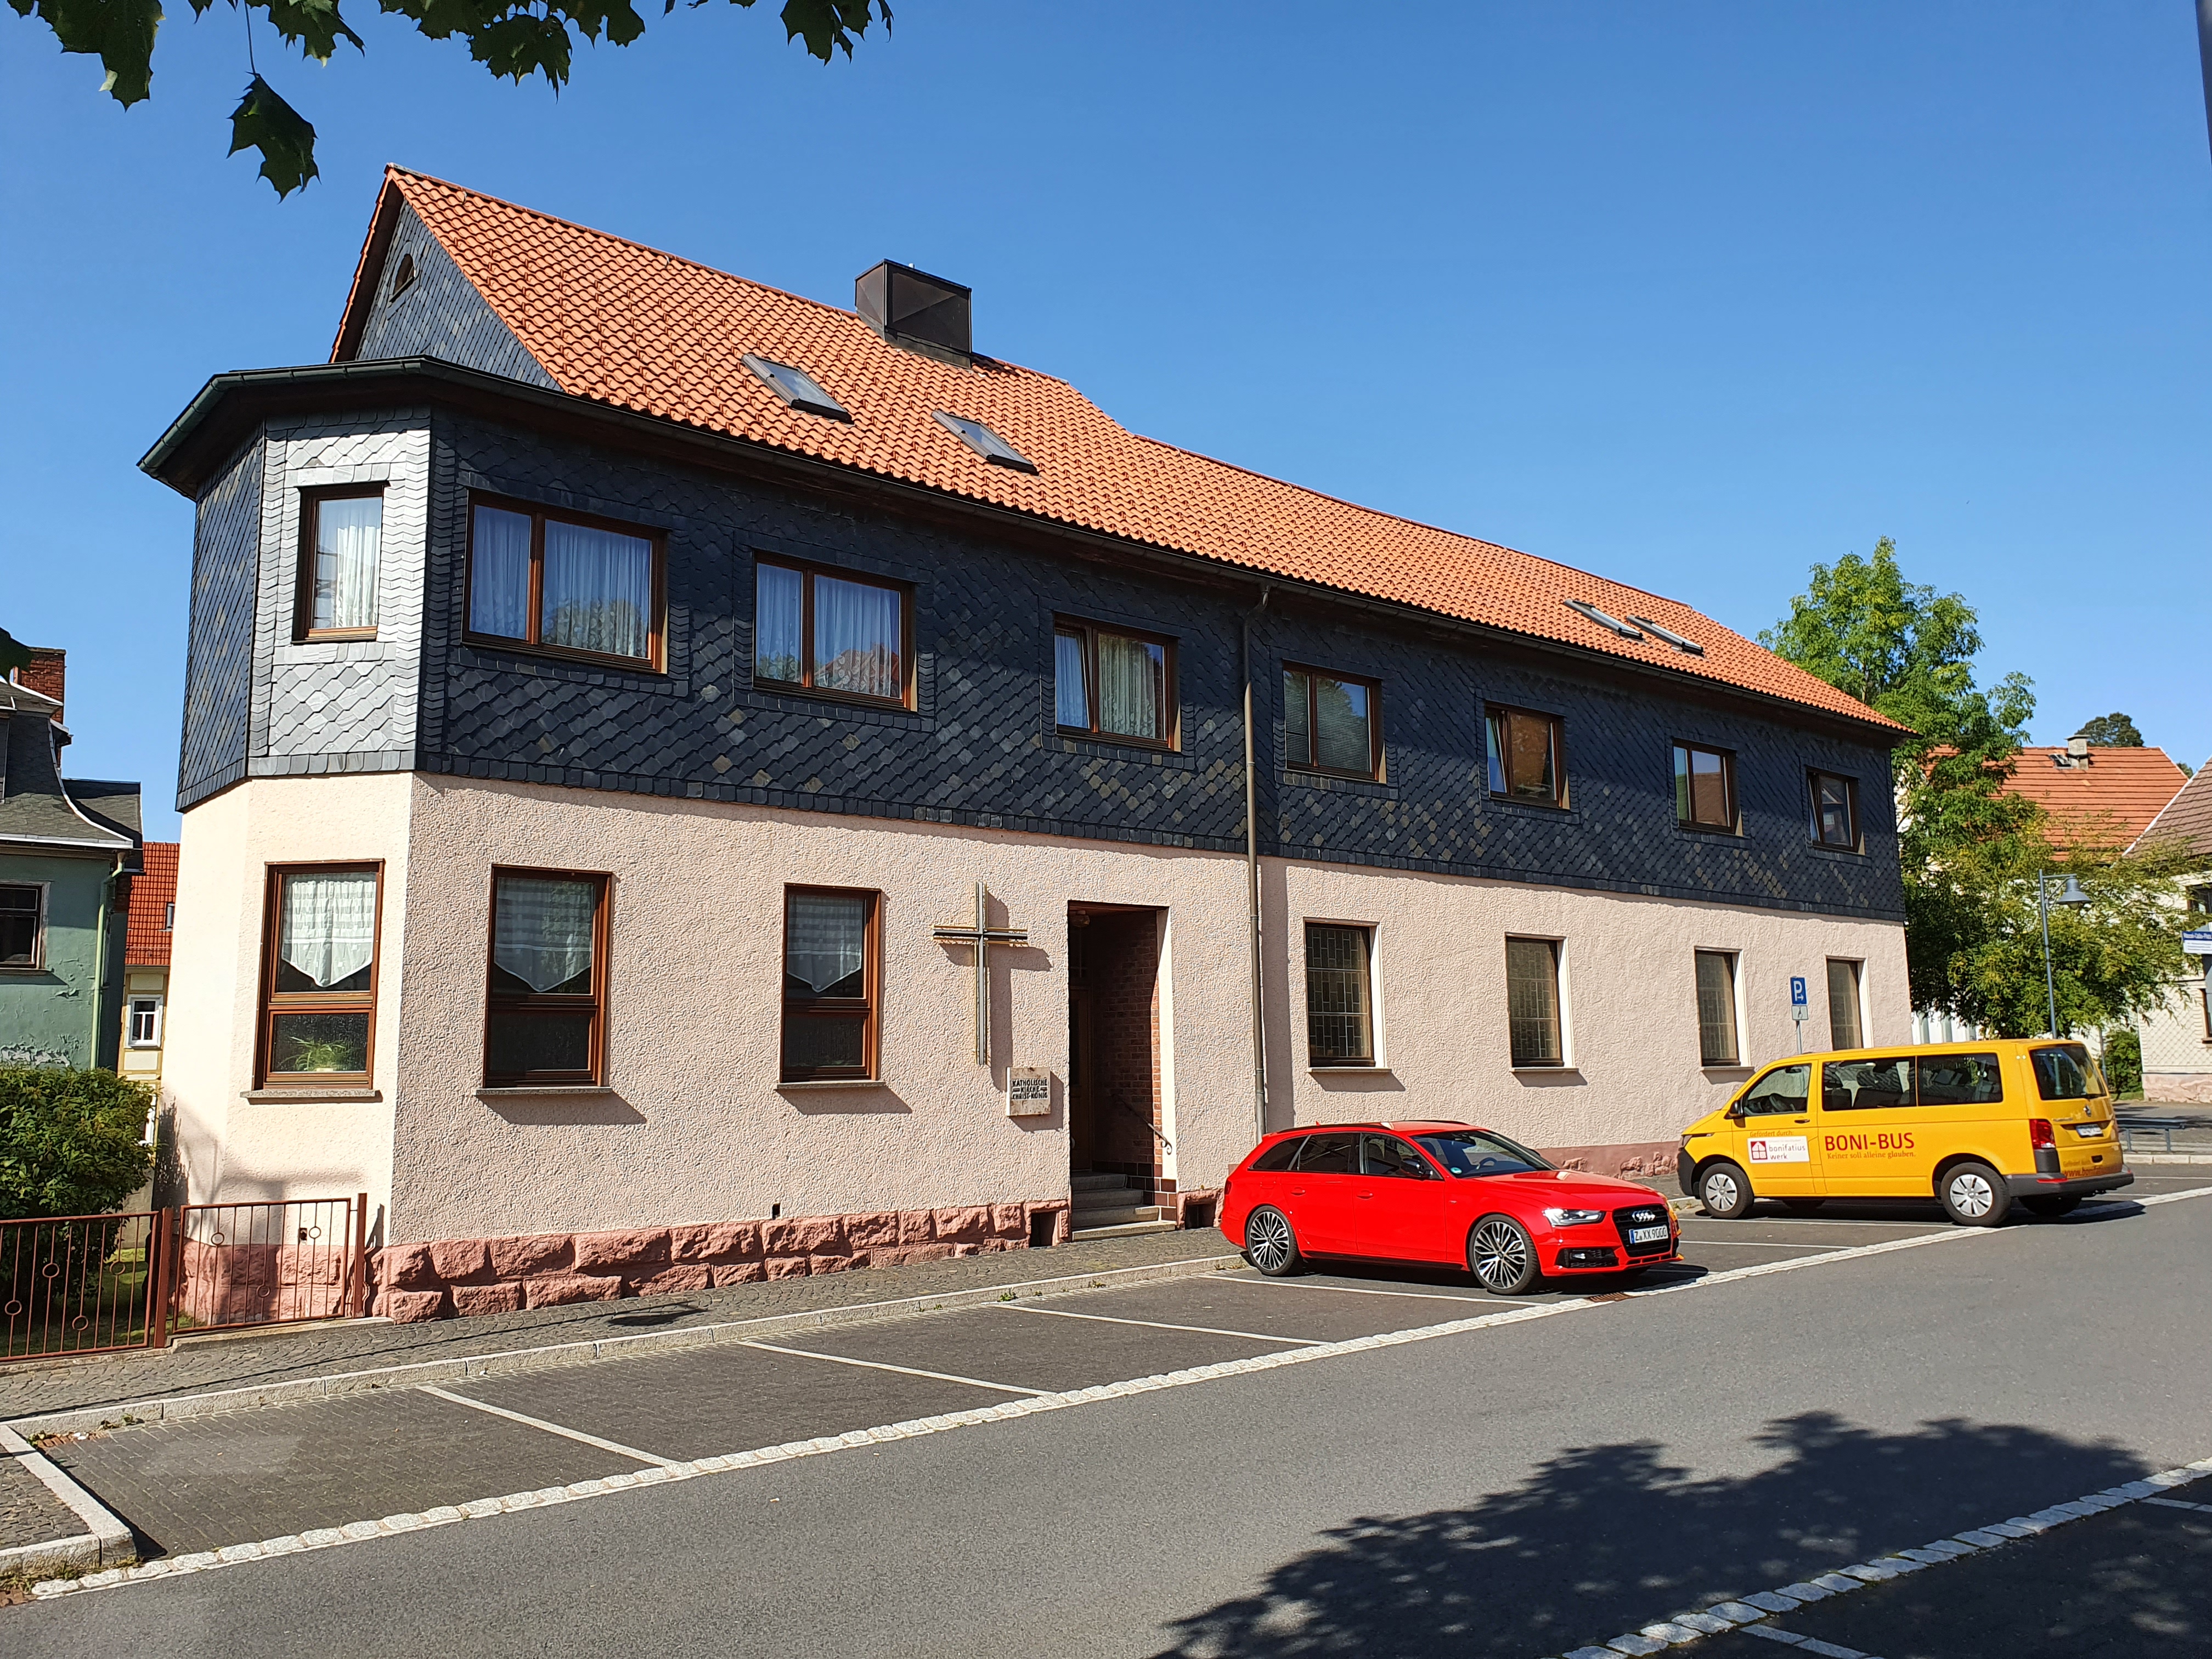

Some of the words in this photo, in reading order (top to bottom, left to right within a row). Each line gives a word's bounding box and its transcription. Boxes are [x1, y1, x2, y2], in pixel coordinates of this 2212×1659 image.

[1793, 980, 1803, 1002] P
[1012, 1079, 1047, 1087] KATHOLISCHE
[1769, 1143, 1806, 1152] bonifatius
[1825, 1132, 1915, 1151] BONI-BUS
